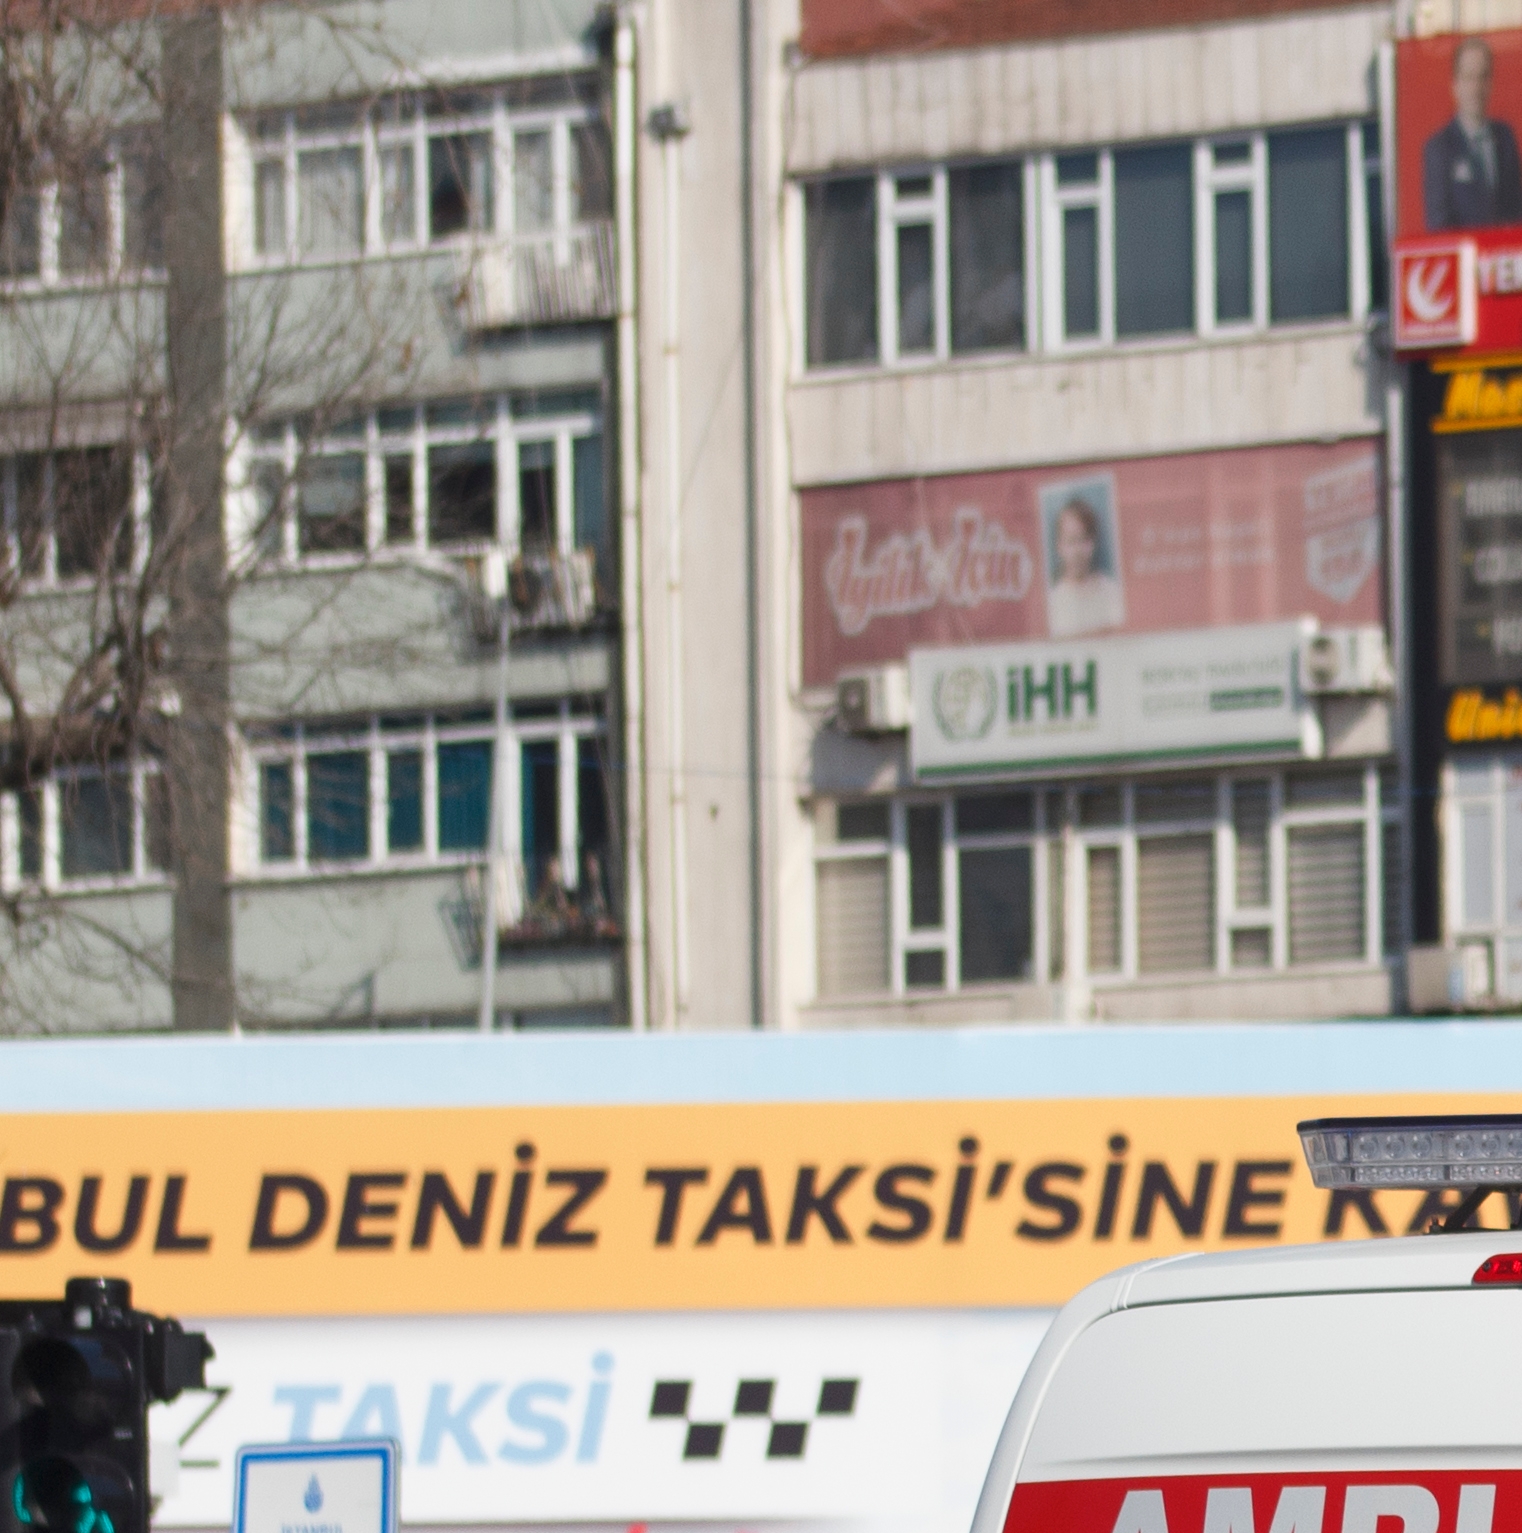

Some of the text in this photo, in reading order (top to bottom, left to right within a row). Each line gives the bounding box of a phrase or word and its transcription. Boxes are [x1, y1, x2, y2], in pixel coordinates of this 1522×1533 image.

[248, 1141, 610, 1253] DENİZ
[644, 1133, 1296, 1249] TAKSİ'SİNE
[272, 1350, 617, 1467] TAKSİ
